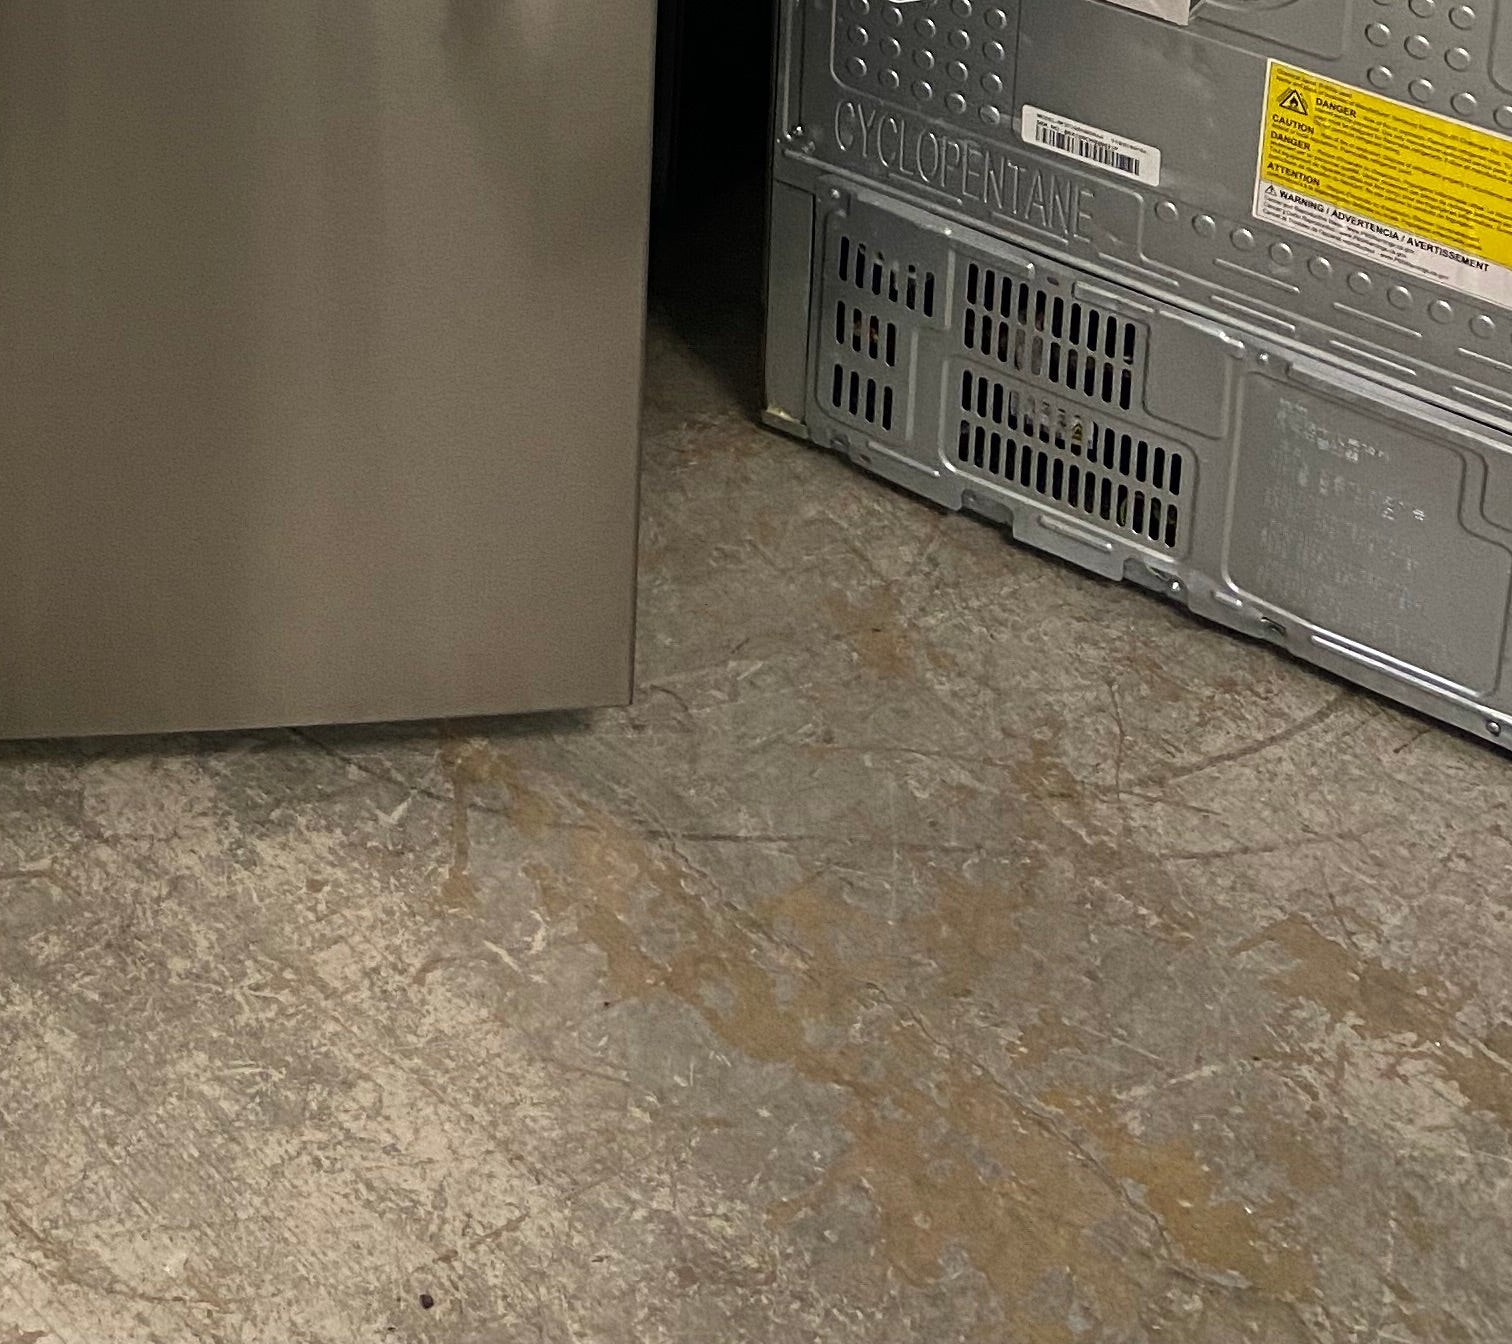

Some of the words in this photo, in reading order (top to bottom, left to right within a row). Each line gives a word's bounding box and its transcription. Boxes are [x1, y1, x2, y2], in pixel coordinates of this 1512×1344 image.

[1315, 97, 1357, 119] DANGER
[1272, 113, 1316, 135] CAUTION
[1270, 130, 1312, 151] DANGER
[834, 98, 1096, 244] CYCLOPENTANE
[1266, 160, 1321, 187] ATTENTION
[1279, 189, 1325, 213] WARNING
[1331, 209, 1400, 241] ADVERTENCIA
[1406, 237, 1491, 272] AVERTISSEMENT
